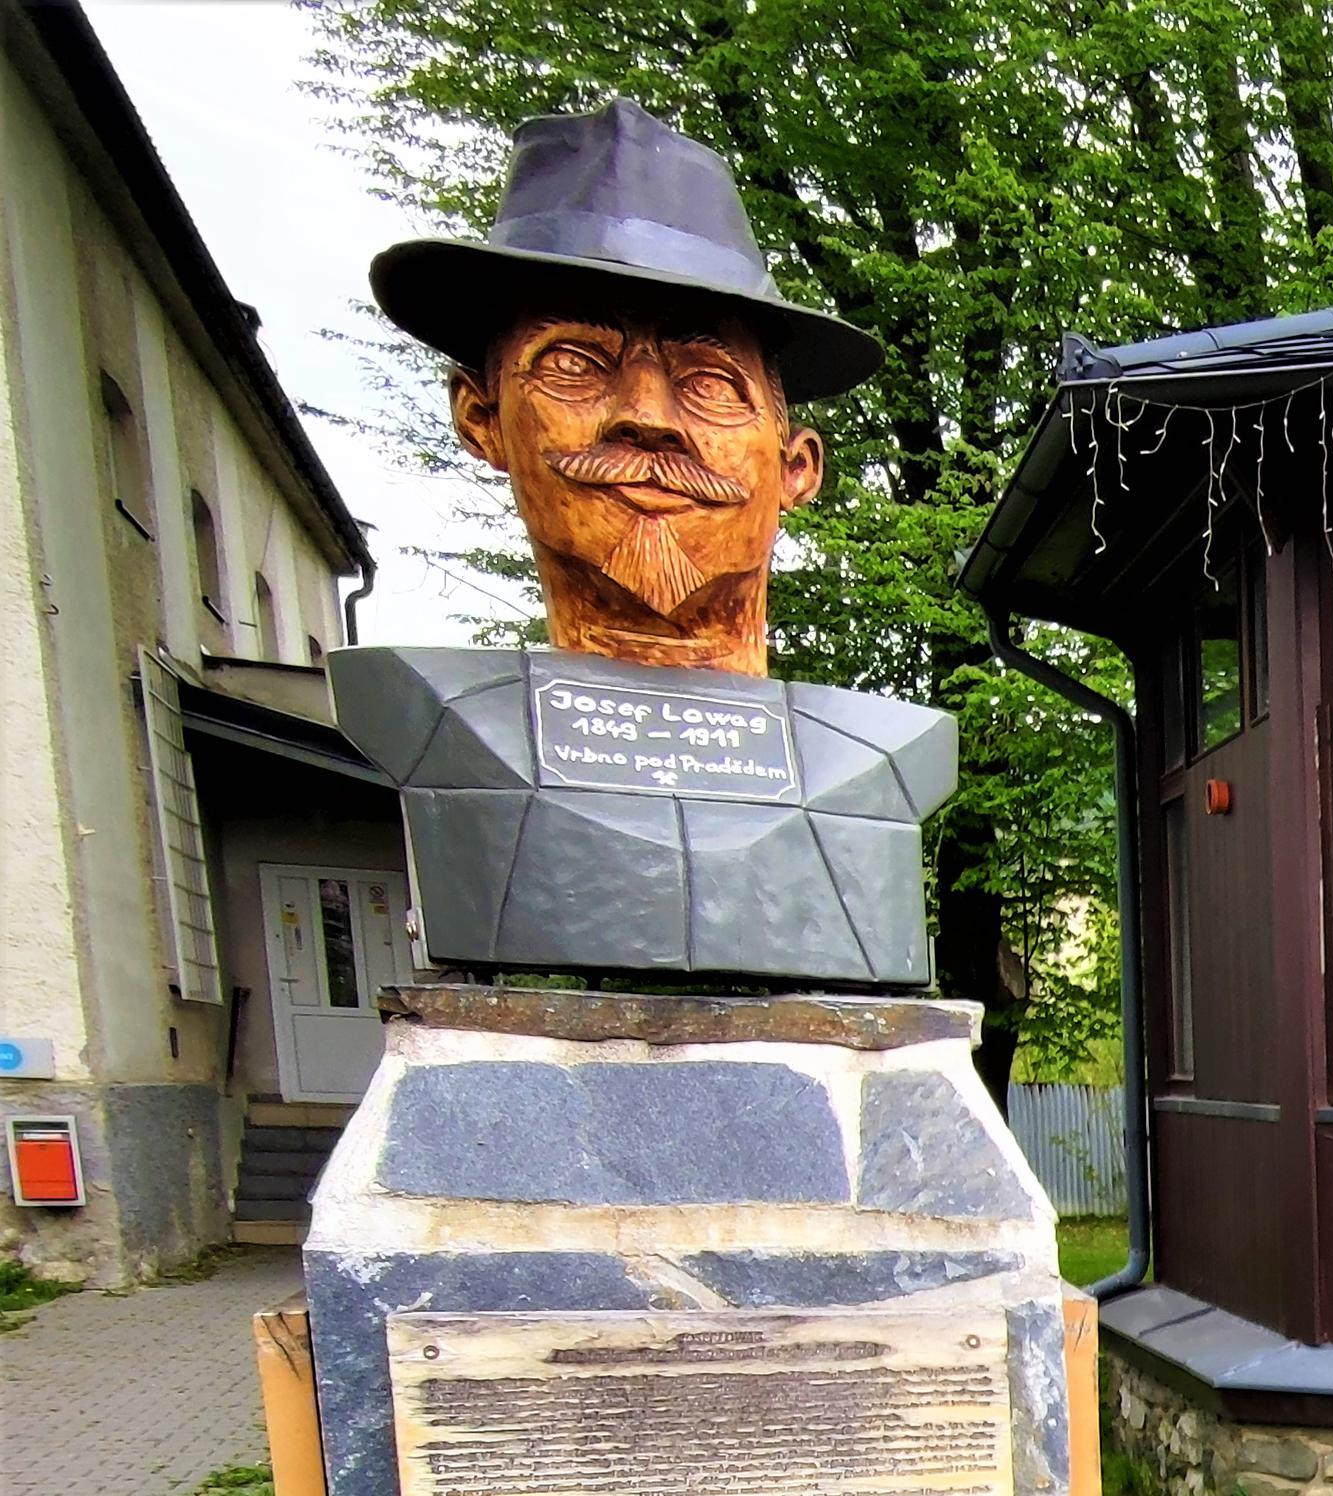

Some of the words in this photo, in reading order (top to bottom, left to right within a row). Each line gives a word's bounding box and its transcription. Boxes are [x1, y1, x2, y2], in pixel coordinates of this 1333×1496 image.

[550, 690, 652, 723] Josef
[661, 703, 768, 734] Lowag
[572, 717, 638, 741] 1849
[679, 728, 741, 748] 1911
[553, 744, 628, 766] Vrbno
[634, 753, 677, 772] pod
